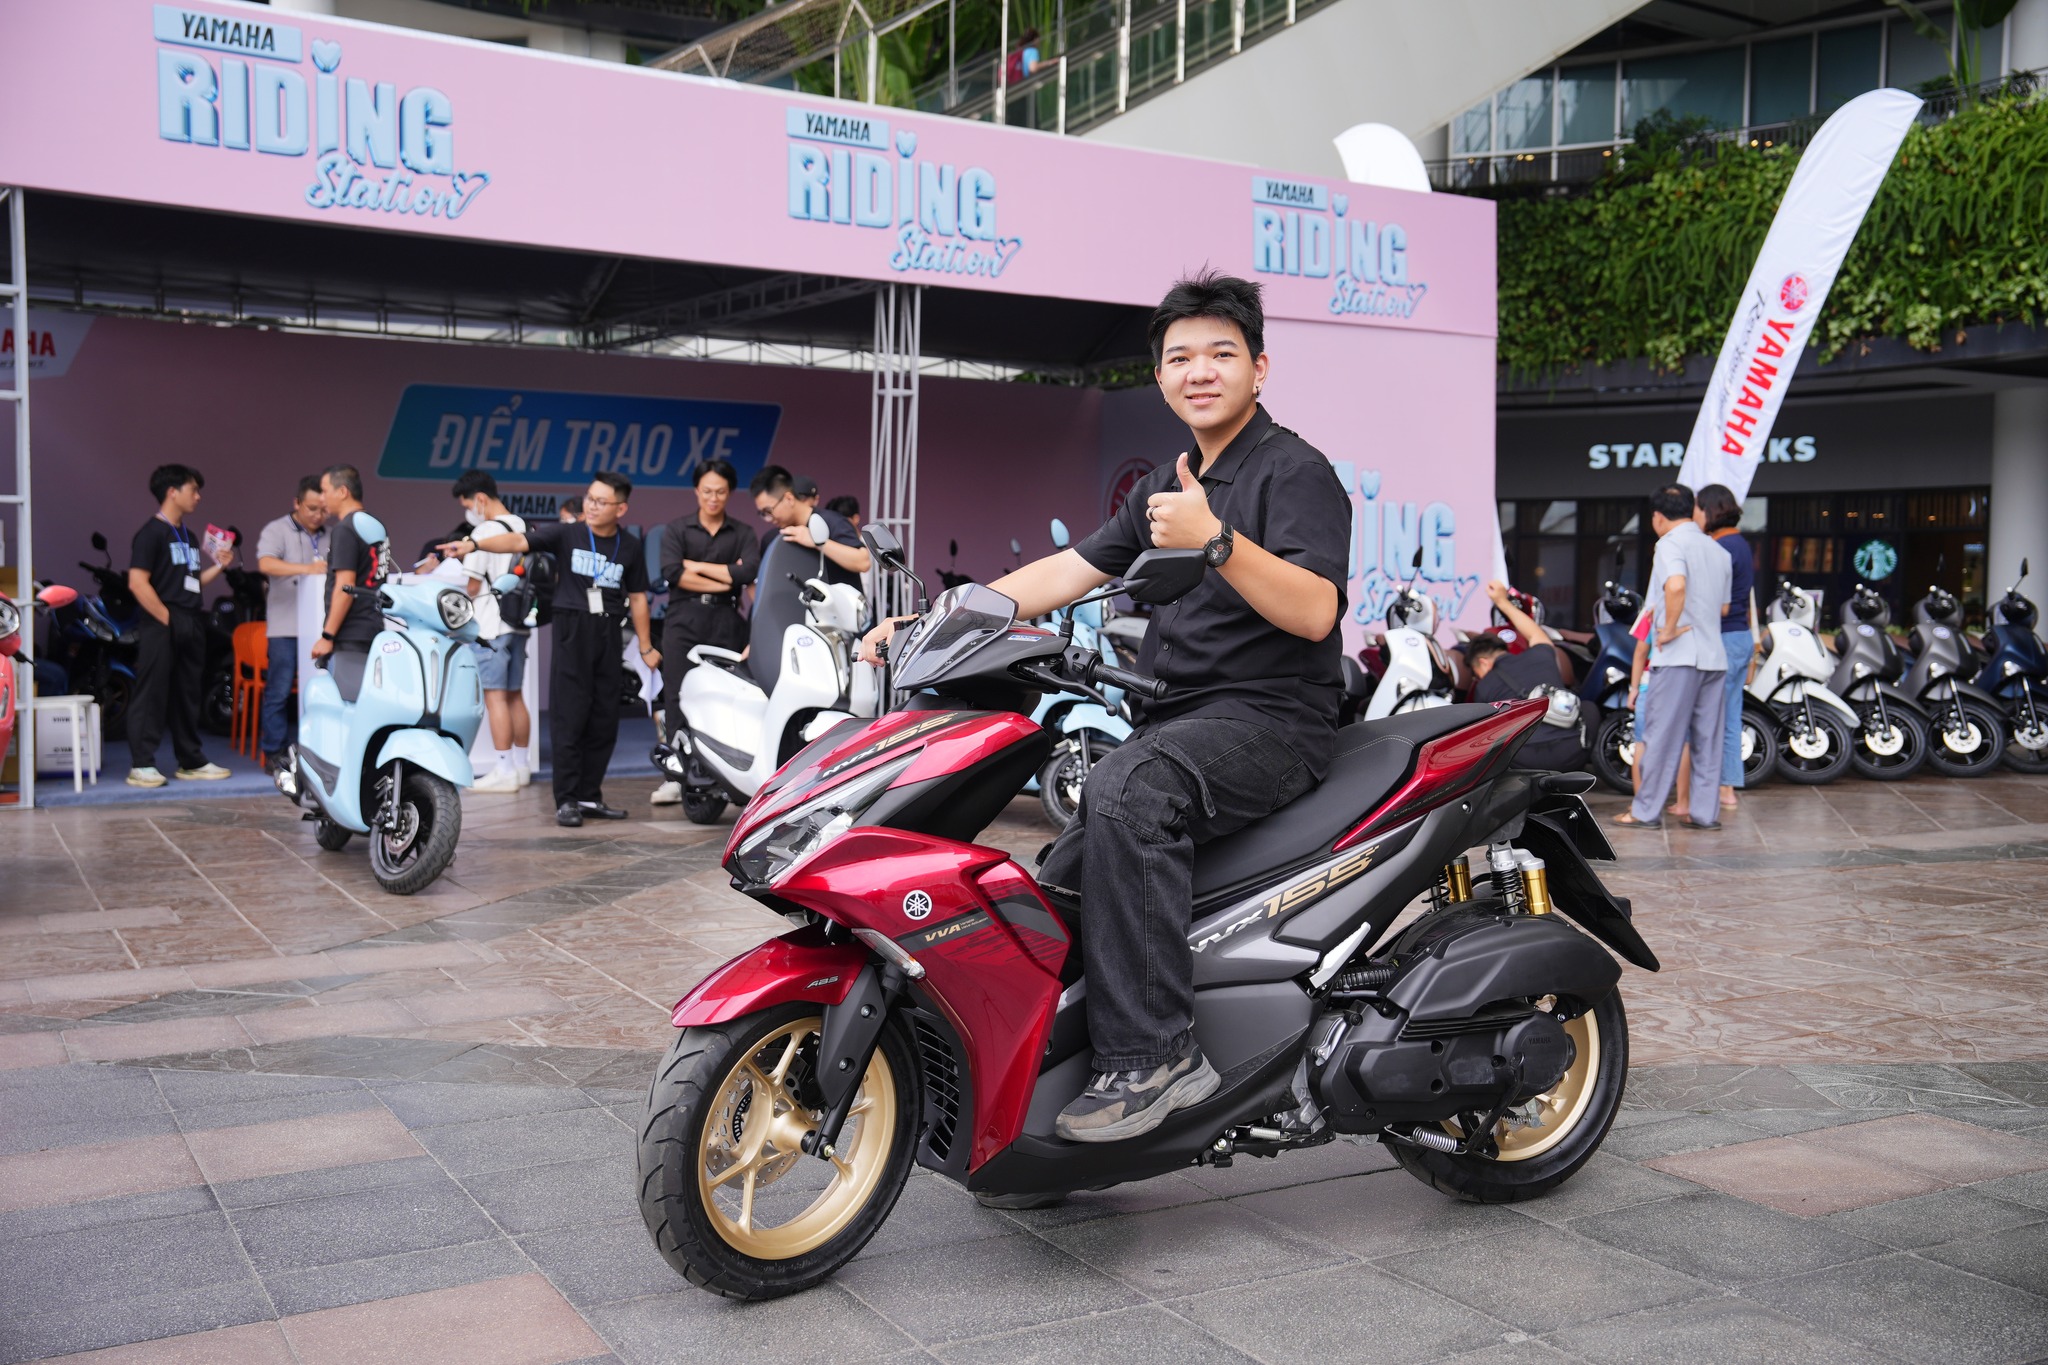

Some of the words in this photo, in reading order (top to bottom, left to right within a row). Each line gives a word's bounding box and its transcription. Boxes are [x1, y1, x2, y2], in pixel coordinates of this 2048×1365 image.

[182, 12, 276, 51] YAMAHA
[806, 112, 871, 142] YAMAHA
[305, 153, 488, 219] Station
[1265, 180, 1314, 204] YAMAHA
[889, 222, 1021, 278] Station
[1328, 271, 1426, 318] Station
[1721, 318, 1796, 457] YAMAHA
[428, 395, 552, 472] ĐIỂM
[563, 419, 673, 477] TRAO
[1588, 435, 1818, 470] STARKS
[501, 494, 557, 515] AMAHA
[875, 712, 958, 752] 155
[1263, 844, 1380, 919] 155
[924, 923, 961, 942] VVA
